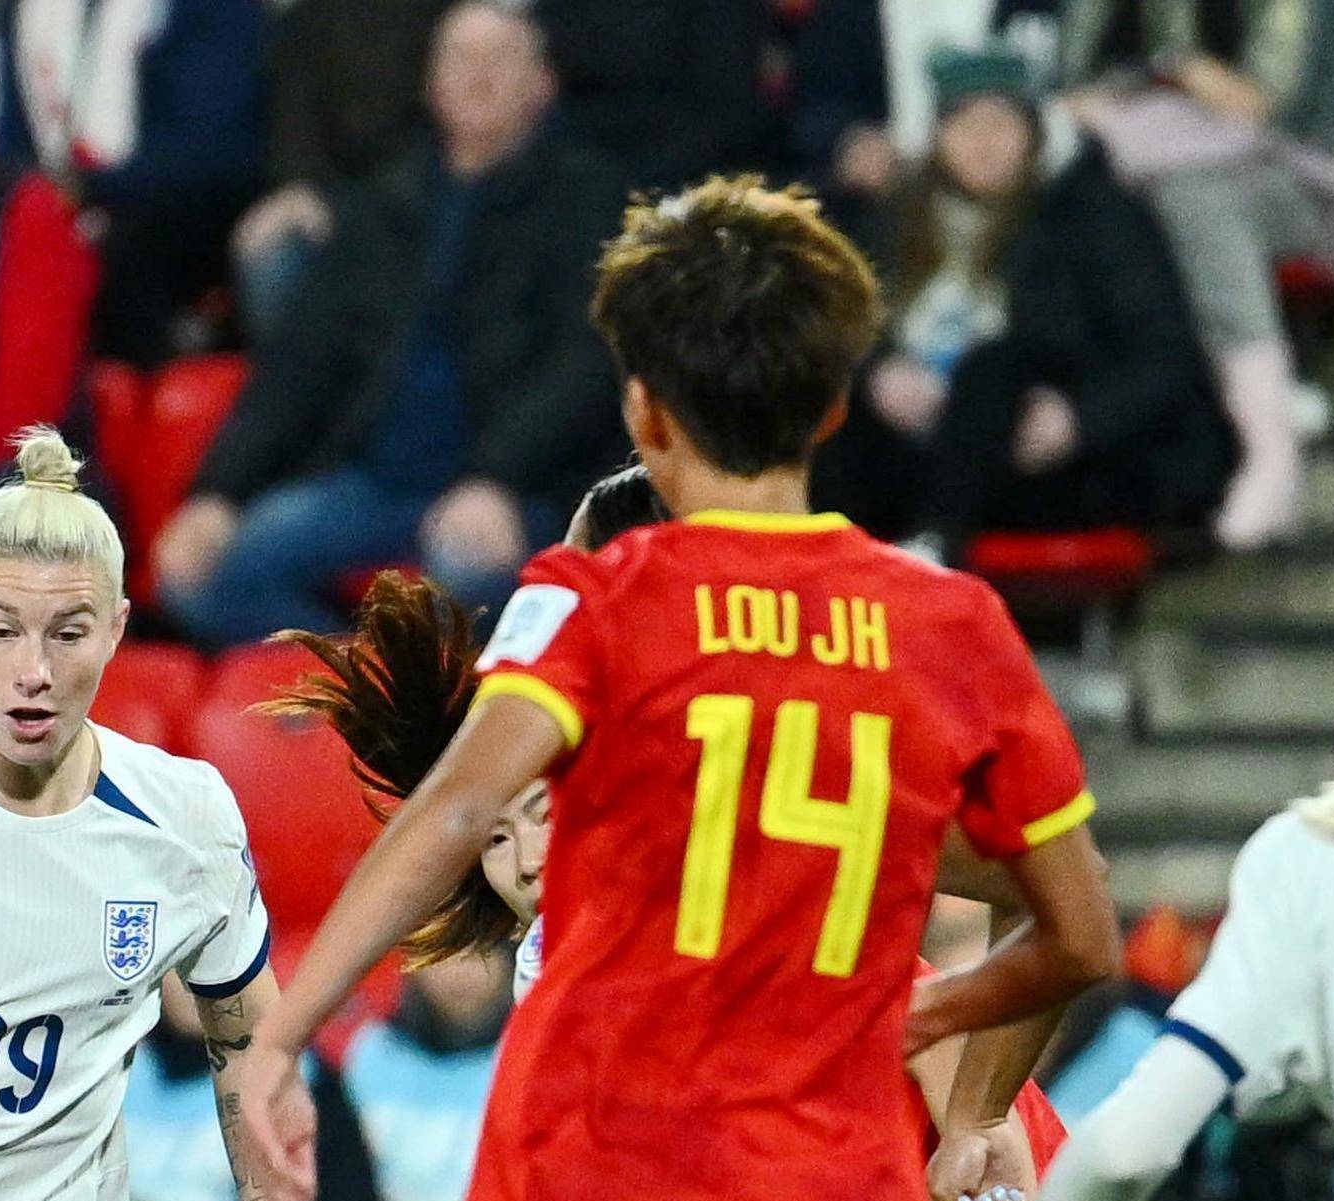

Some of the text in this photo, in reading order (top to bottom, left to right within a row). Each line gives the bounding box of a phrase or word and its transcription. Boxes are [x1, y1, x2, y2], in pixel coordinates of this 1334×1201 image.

[694, 583, 891, 672] LOU JH
[673, 693, 893, 979] 14
